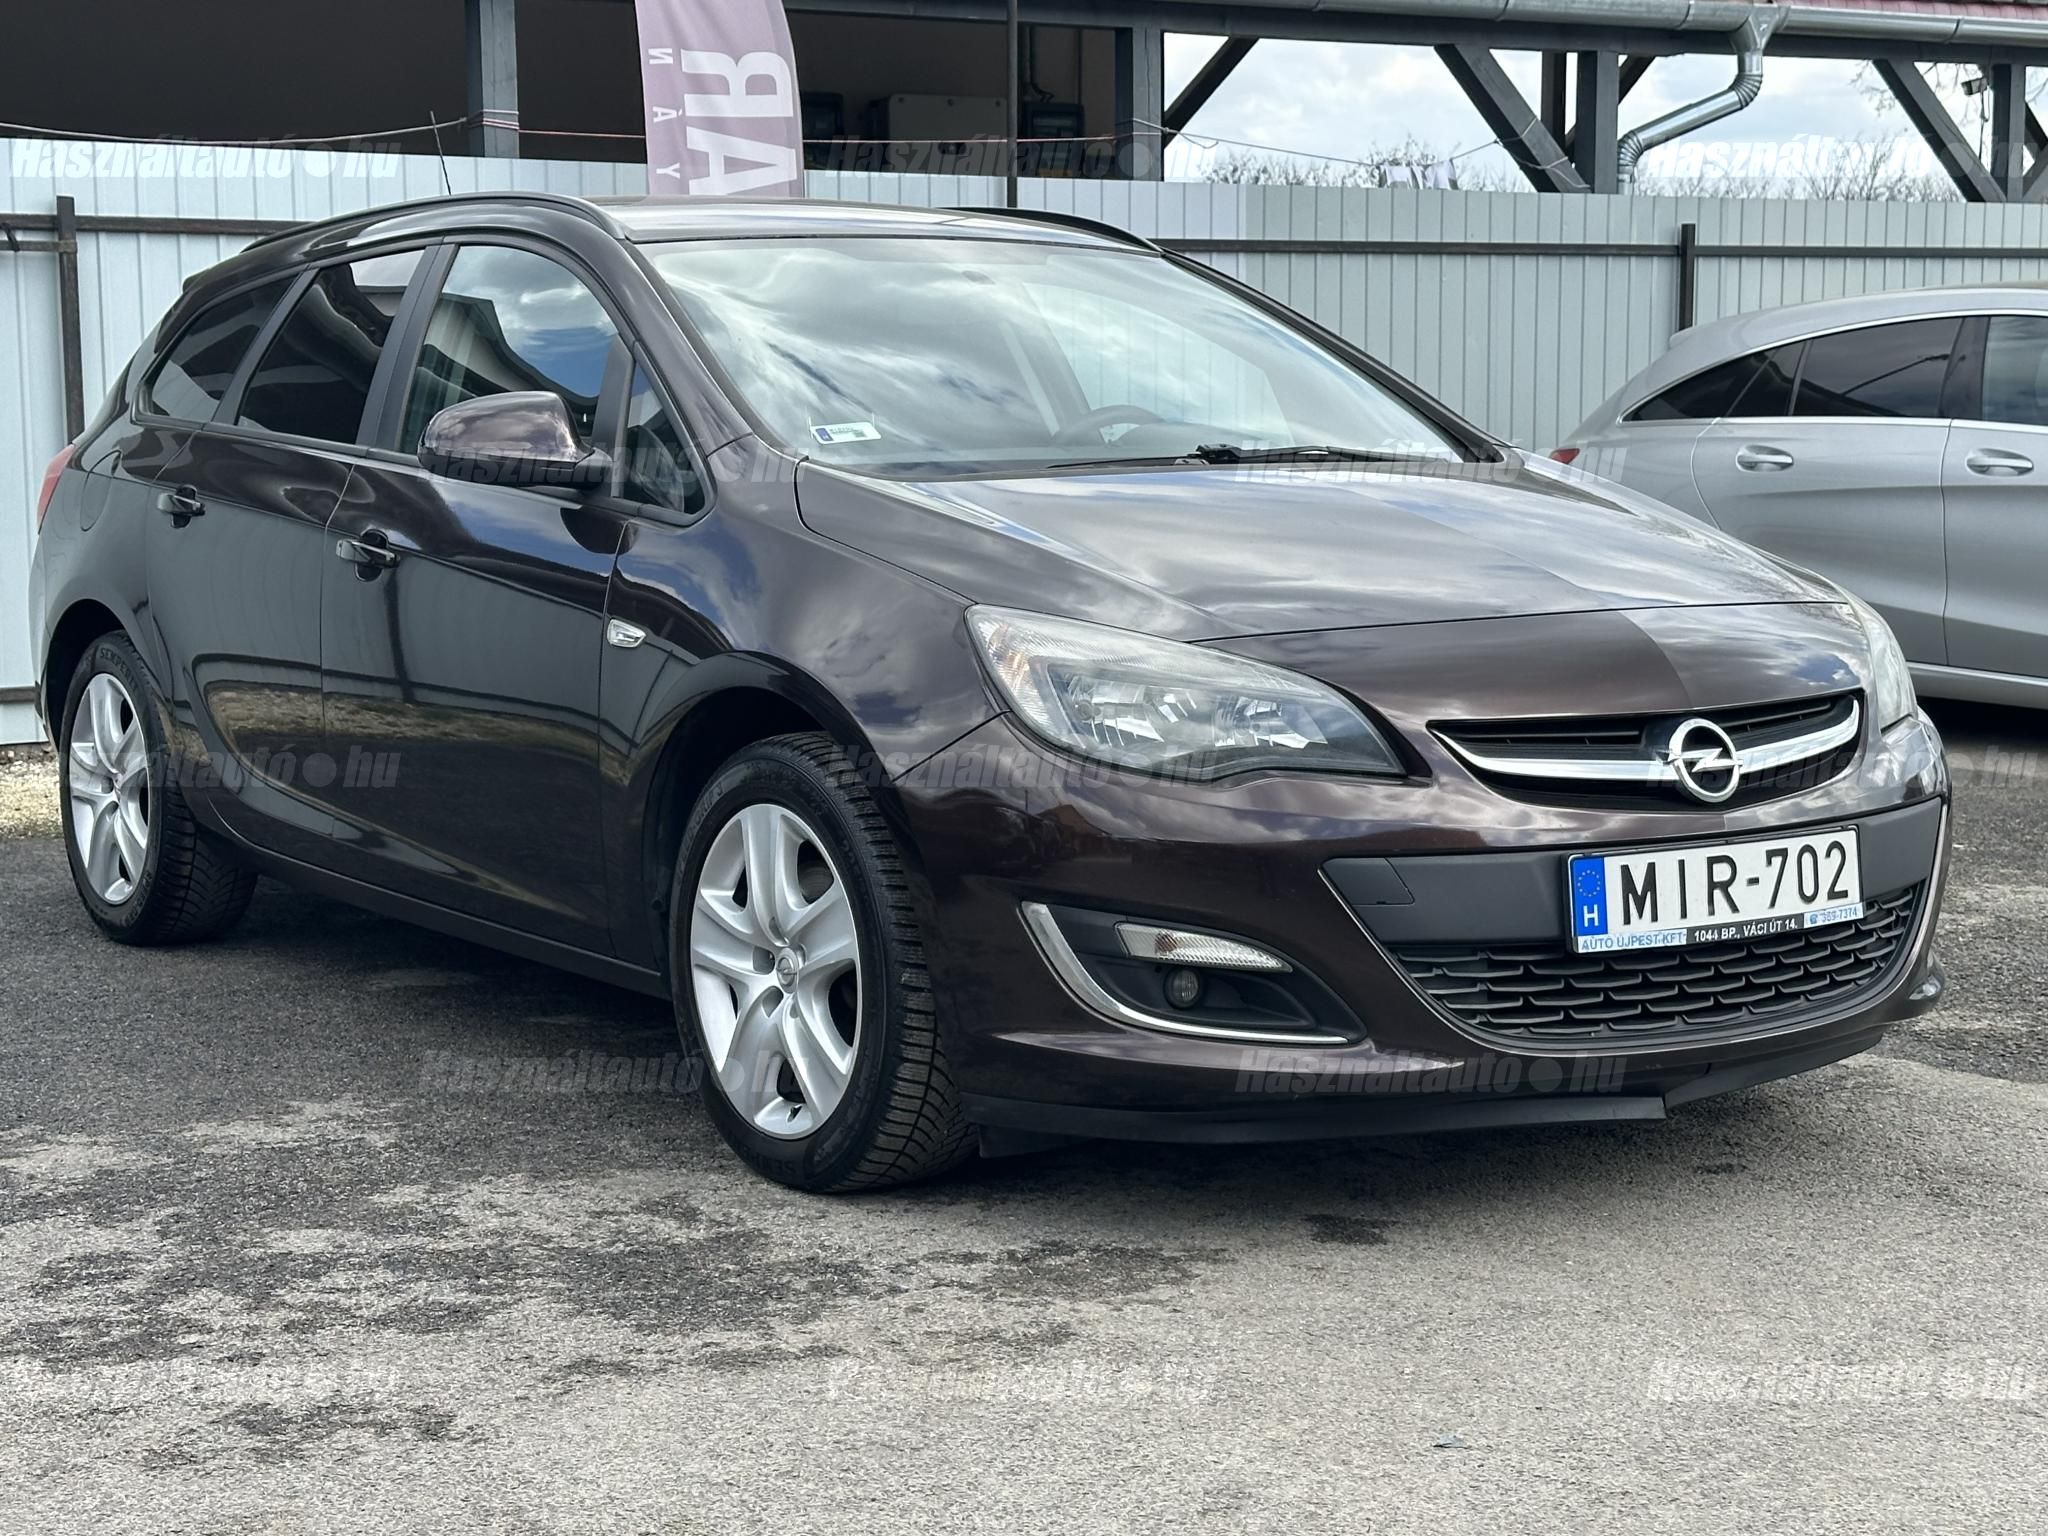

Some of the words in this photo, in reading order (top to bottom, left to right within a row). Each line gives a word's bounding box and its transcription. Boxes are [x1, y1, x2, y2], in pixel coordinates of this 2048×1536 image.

[1620, 840, 1850, 926] MIR-702
[1582, 903, 1600, 928] H
[1694, 929, 1719, 942] 1044
[1743, 921, 1767, 937] VÁCI
[1769, 918, 1783, 933] ÚT
